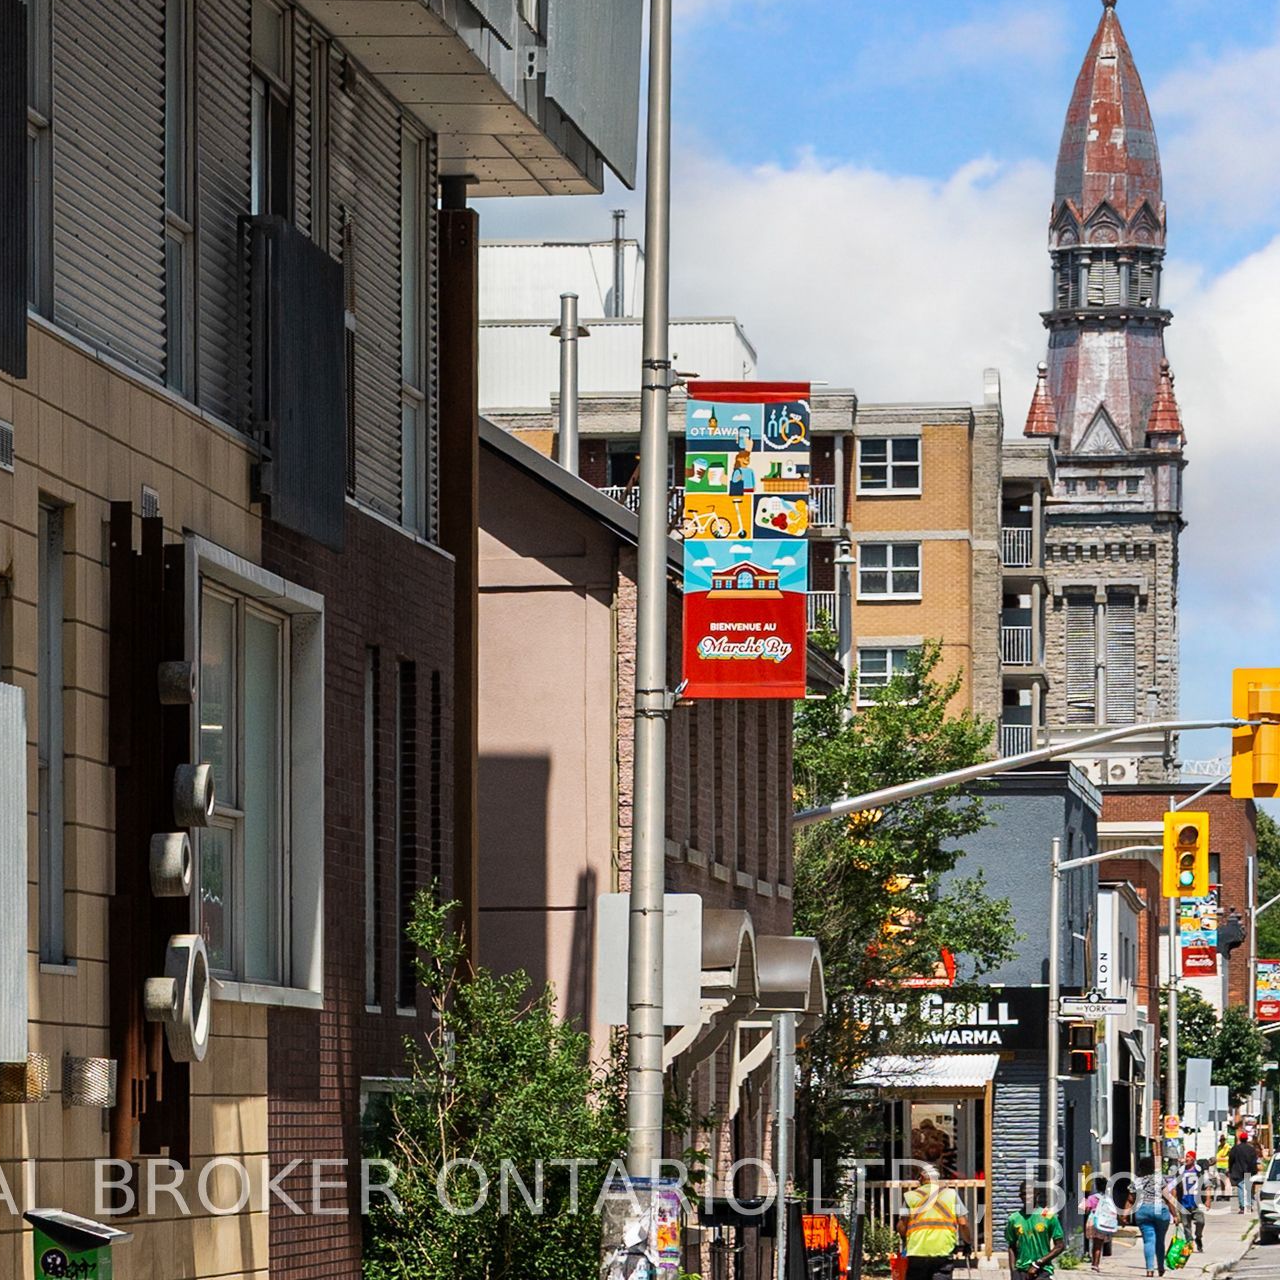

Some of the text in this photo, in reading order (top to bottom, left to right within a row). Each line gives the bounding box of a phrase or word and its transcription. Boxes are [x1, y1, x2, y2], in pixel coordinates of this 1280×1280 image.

[690, 427, 739, 437] OTTAWA
[709, 622, 777, 631] BIENVENUE AU
[701, 636, 792, 658] Marché By
